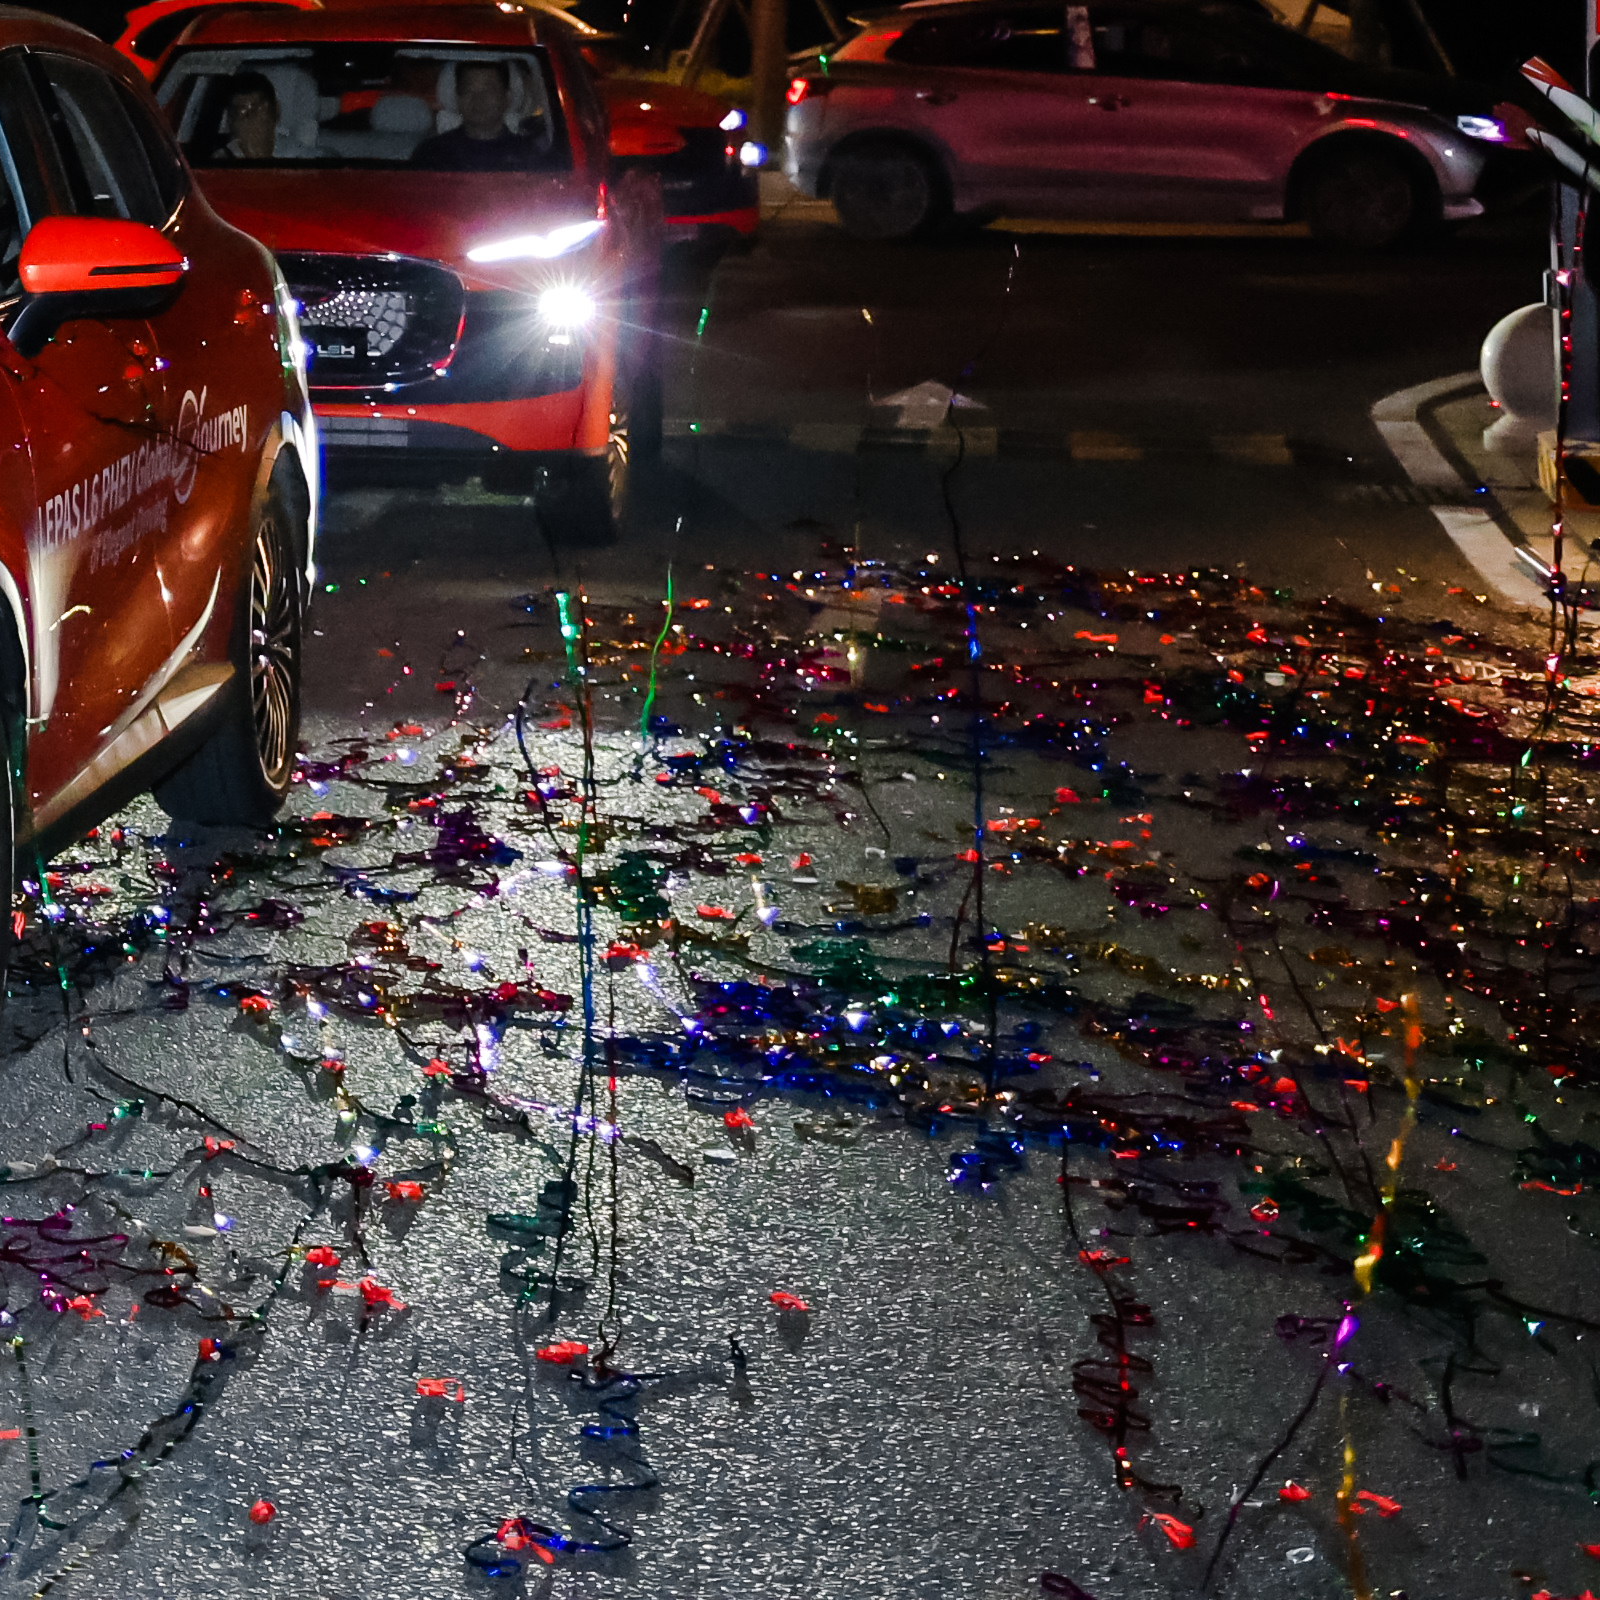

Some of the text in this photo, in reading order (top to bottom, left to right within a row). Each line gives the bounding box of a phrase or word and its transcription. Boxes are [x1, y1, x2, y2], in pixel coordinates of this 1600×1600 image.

[37, 483, 81, 554] LEPAS
[83, 473, 101, 532] L6
[101, 451, 136, 519] PHEV
